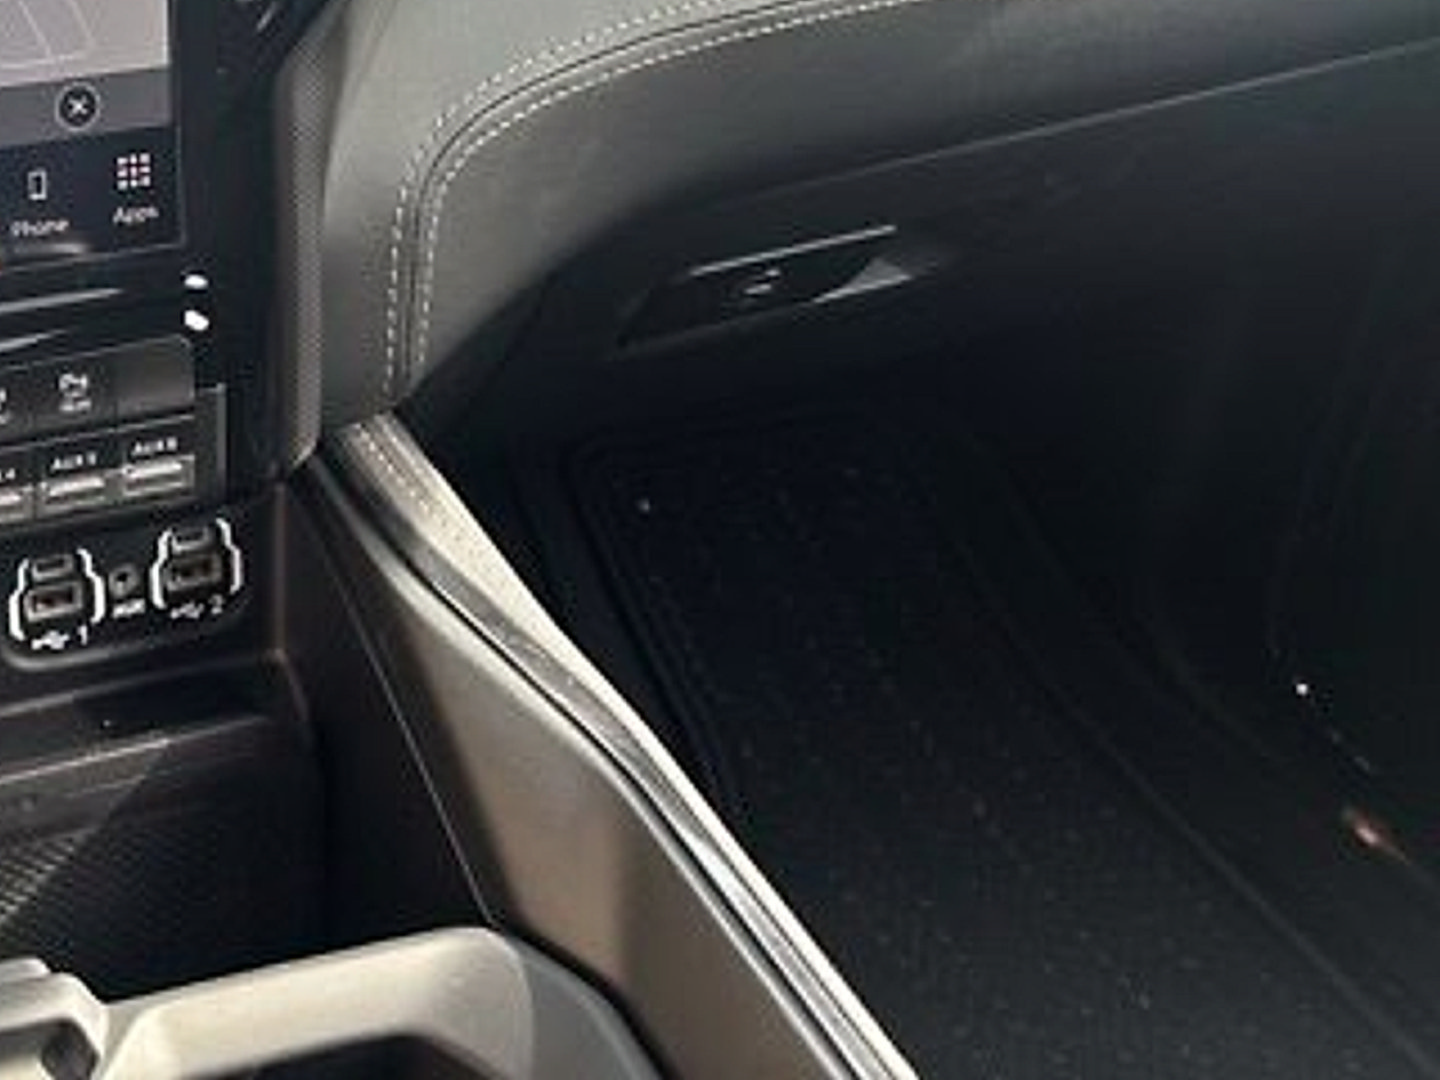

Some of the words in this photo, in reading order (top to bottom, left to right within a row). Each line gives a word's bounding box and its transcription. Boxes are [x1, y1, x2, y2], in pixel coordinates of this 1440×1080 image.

[113, 204, 160, 225] Apps
[9, 219, 70, 239] Phone
[131, 440, 165, 457] AUX
[50, 454, 83, 471] AUX
